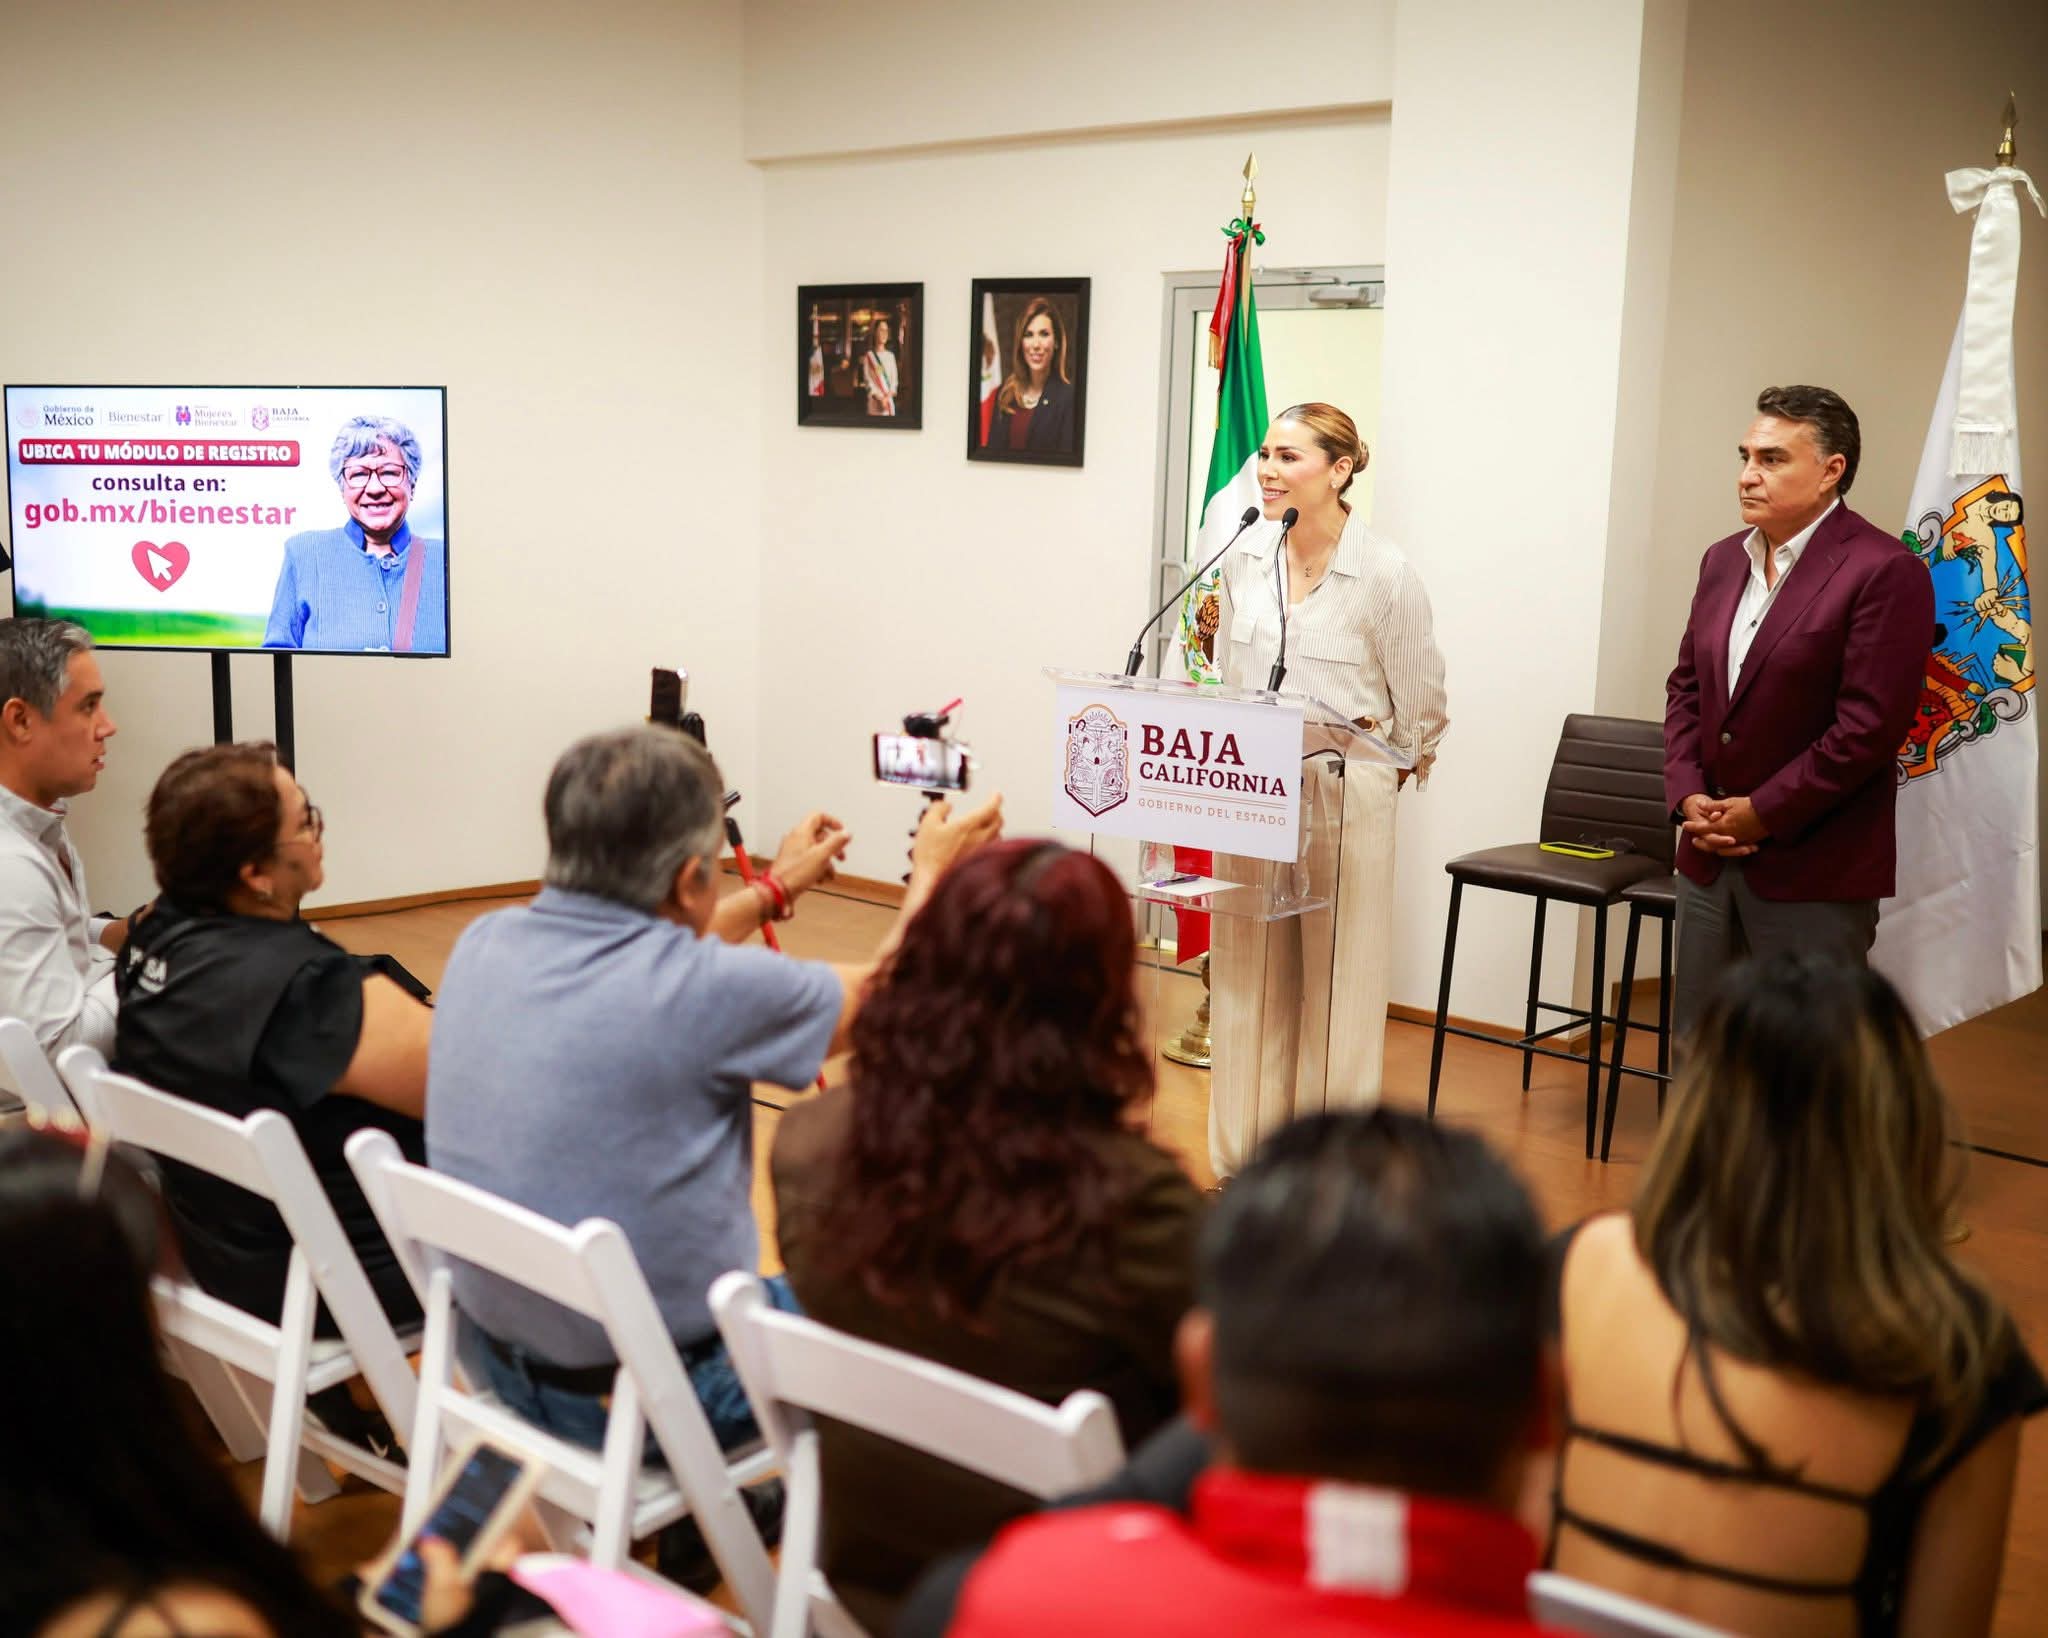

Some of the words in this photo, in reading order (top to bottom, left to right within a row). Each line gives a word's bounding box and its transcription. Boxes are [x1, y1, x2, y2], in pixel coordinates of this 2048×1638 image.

[44, 413, 94, 427] México
[108, 411, 164, 423] Bienestar
[22, 443, 75, 460] UBICA
[78, 444, 99, 460] TU
[103, 441, 179, 461] MÓDULO
[183, 445, 204, 461] DE
[208, 445, 292, 462] REGISTRO
[92, 473, 186, 492] consulta
[192, 476, 226, 492] en:
[25, 498, 297, 529] gob.mx/bienestar
[1140, 724, 1245, 767] BAJA
[1139, 761, 1288, 797] CALIFORNIA
[1138, 798, 1203, 816] GOBIERNO
[1207, 807, 1231, 819] DEL
[1236, 811, 1287, 826] ESTADO
